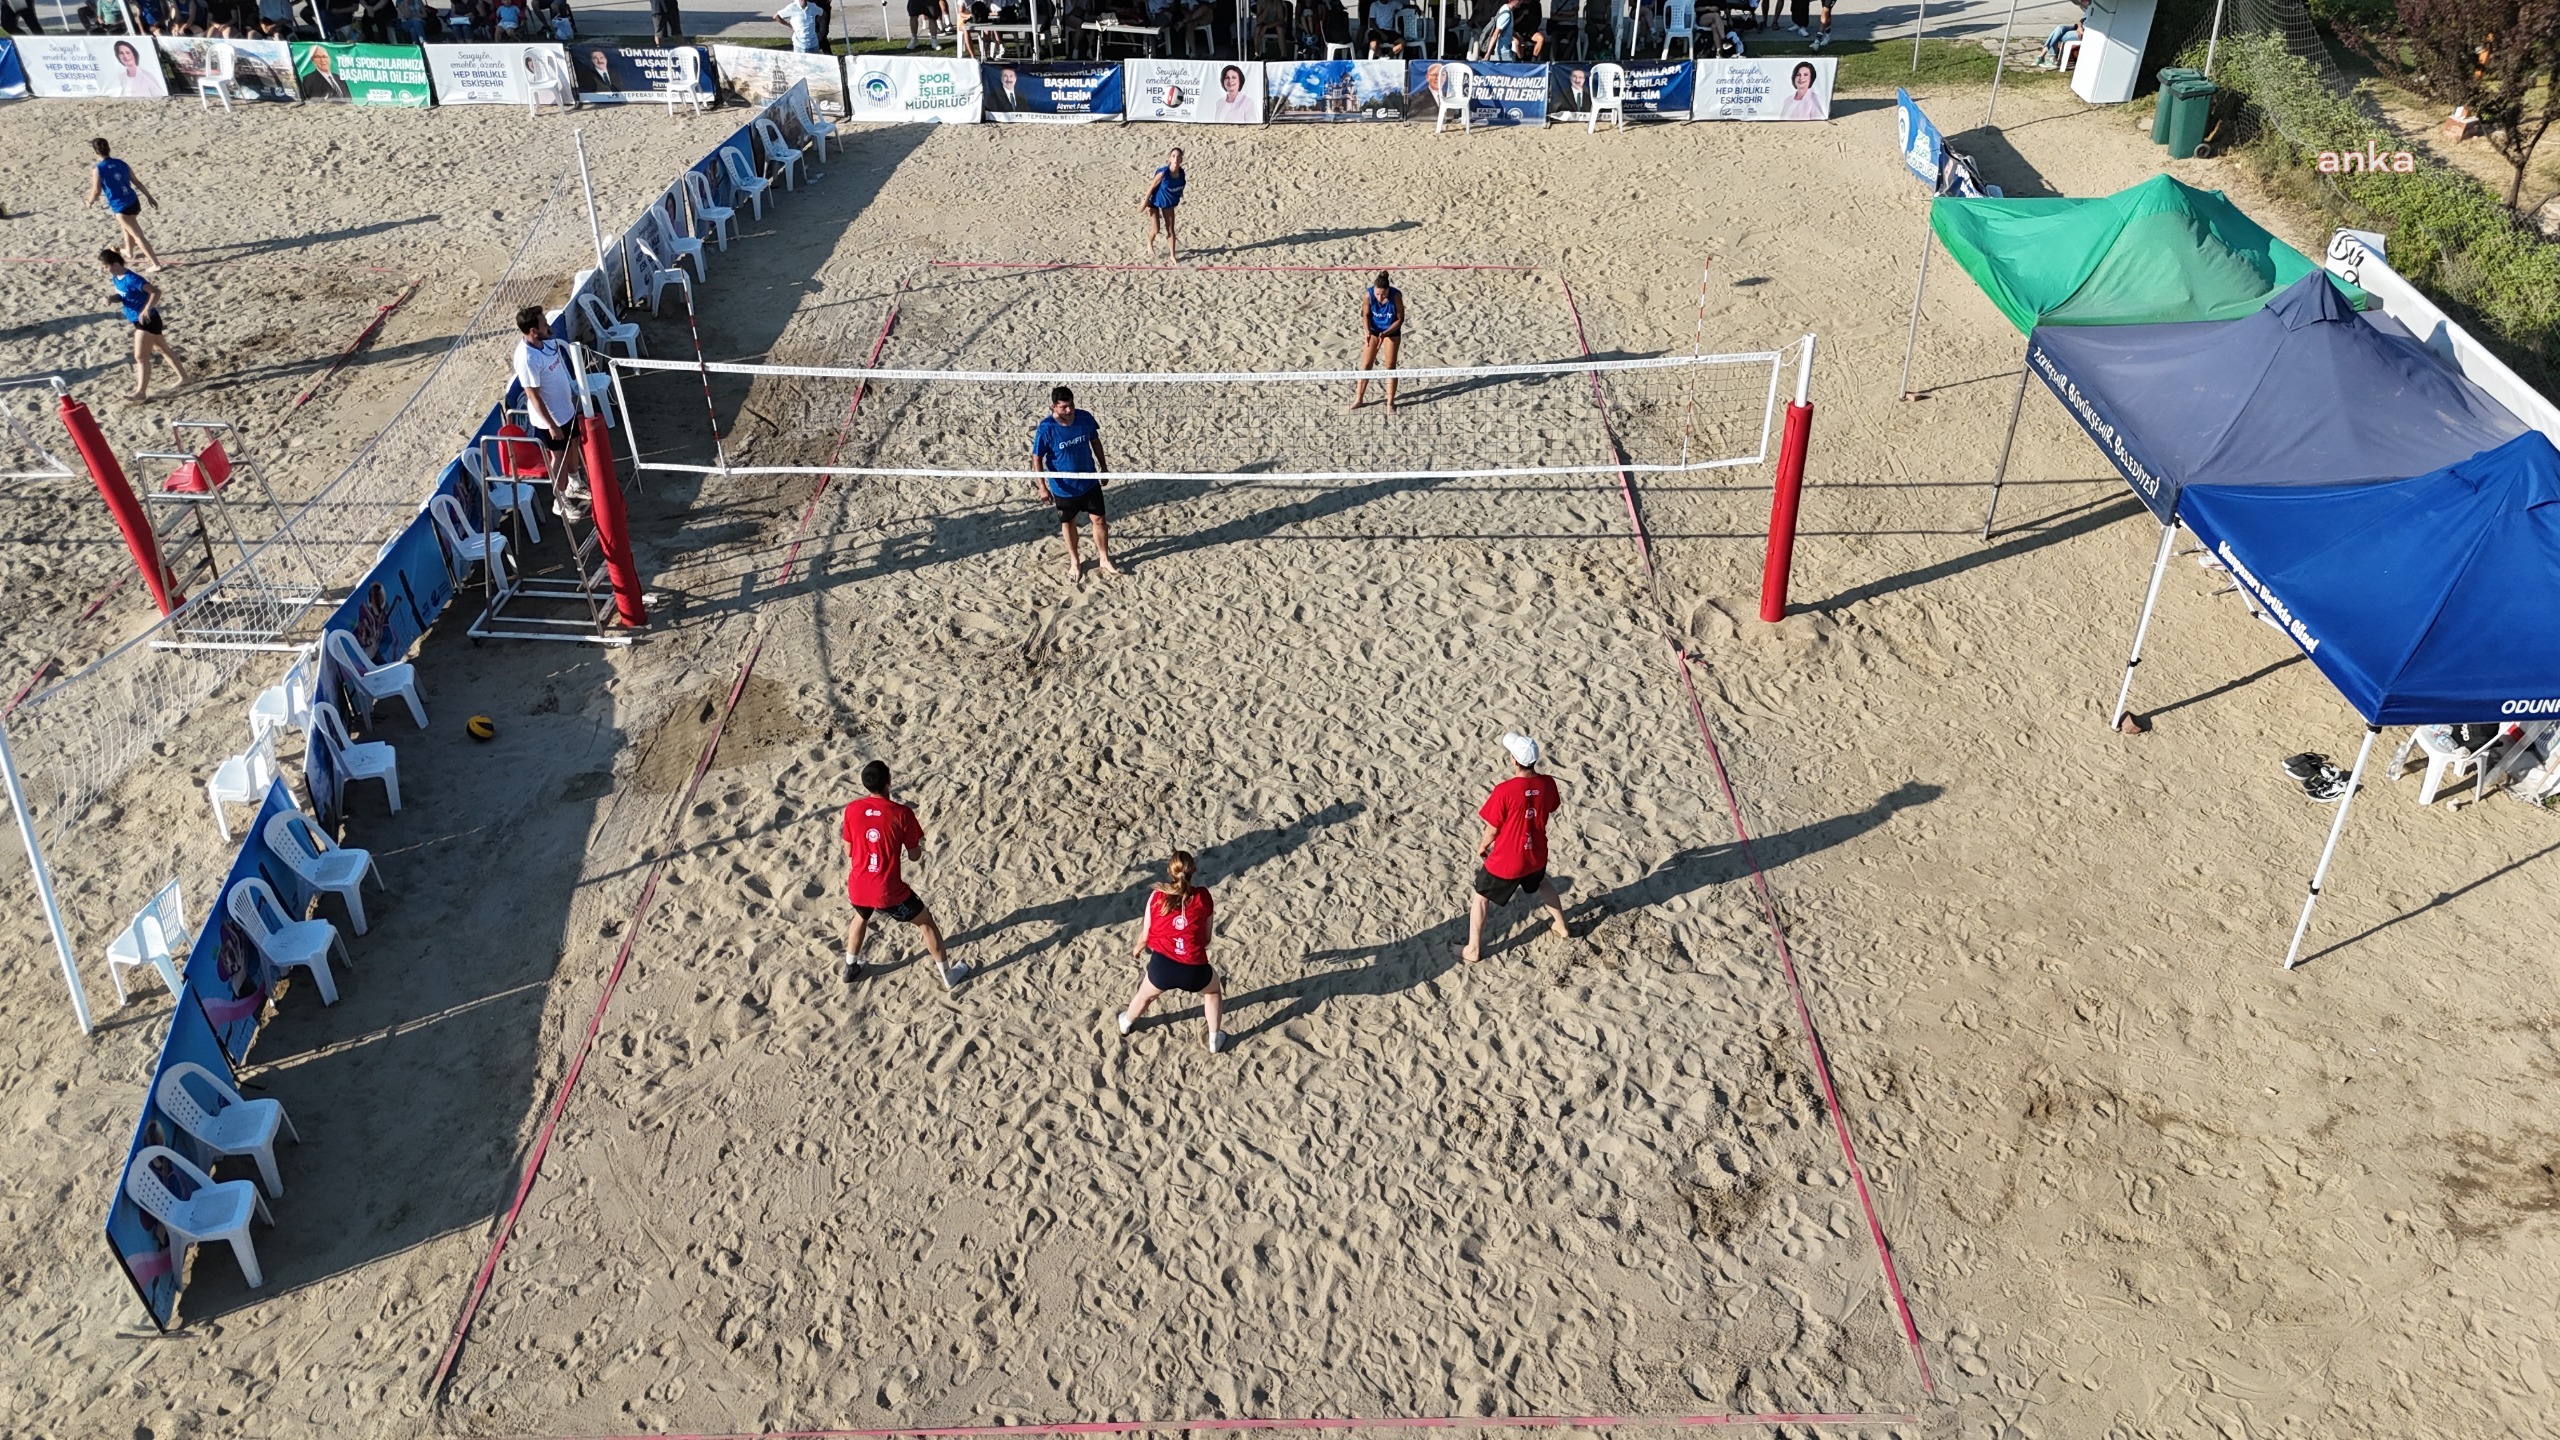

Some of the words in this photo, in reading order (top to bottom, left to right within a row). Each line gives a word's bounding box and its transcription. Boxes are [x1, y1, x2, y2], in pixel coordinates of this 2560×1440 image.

[619, 48, 641, 57] TÜM
[336, 54, 354, 68] TÜM
[355, 57, 425, 71] SPORCULARIMIZA
[339, 68, 389, 84] BAŞARILAR
[453, 70, 471, 78] HEP
[471, 69, 508, 79] BİRLİKLE
[1624, 65, 1682, 79] TAKIMLARA
[460, 79, 505, 88] ESKİŞEHİR
[919, 74, 950, 85] SPOR
[1044, 78, 1098, 89] BAŞARILAR
[1472, 75, 1546, 89] SPORCULARIMIZA
[919, 83, 955, 99] İŞLERİ
[1051, 90, 1091, 101] DİLERİM
[1146, 87, 1163, 95] HEP
[1715, 86, 1733, 95] HEP
[1734, 85, 1770, 95] BİRLİKLE
[1720, 94, 1763, 105] ESKİŞEHİR
[2068, 383, 2114, 449] BÜYÜKŞEHİR
[2114, 435, 2160, 499] BELEDİYESİ
[2290, 619, 2320, 654] Güzel
